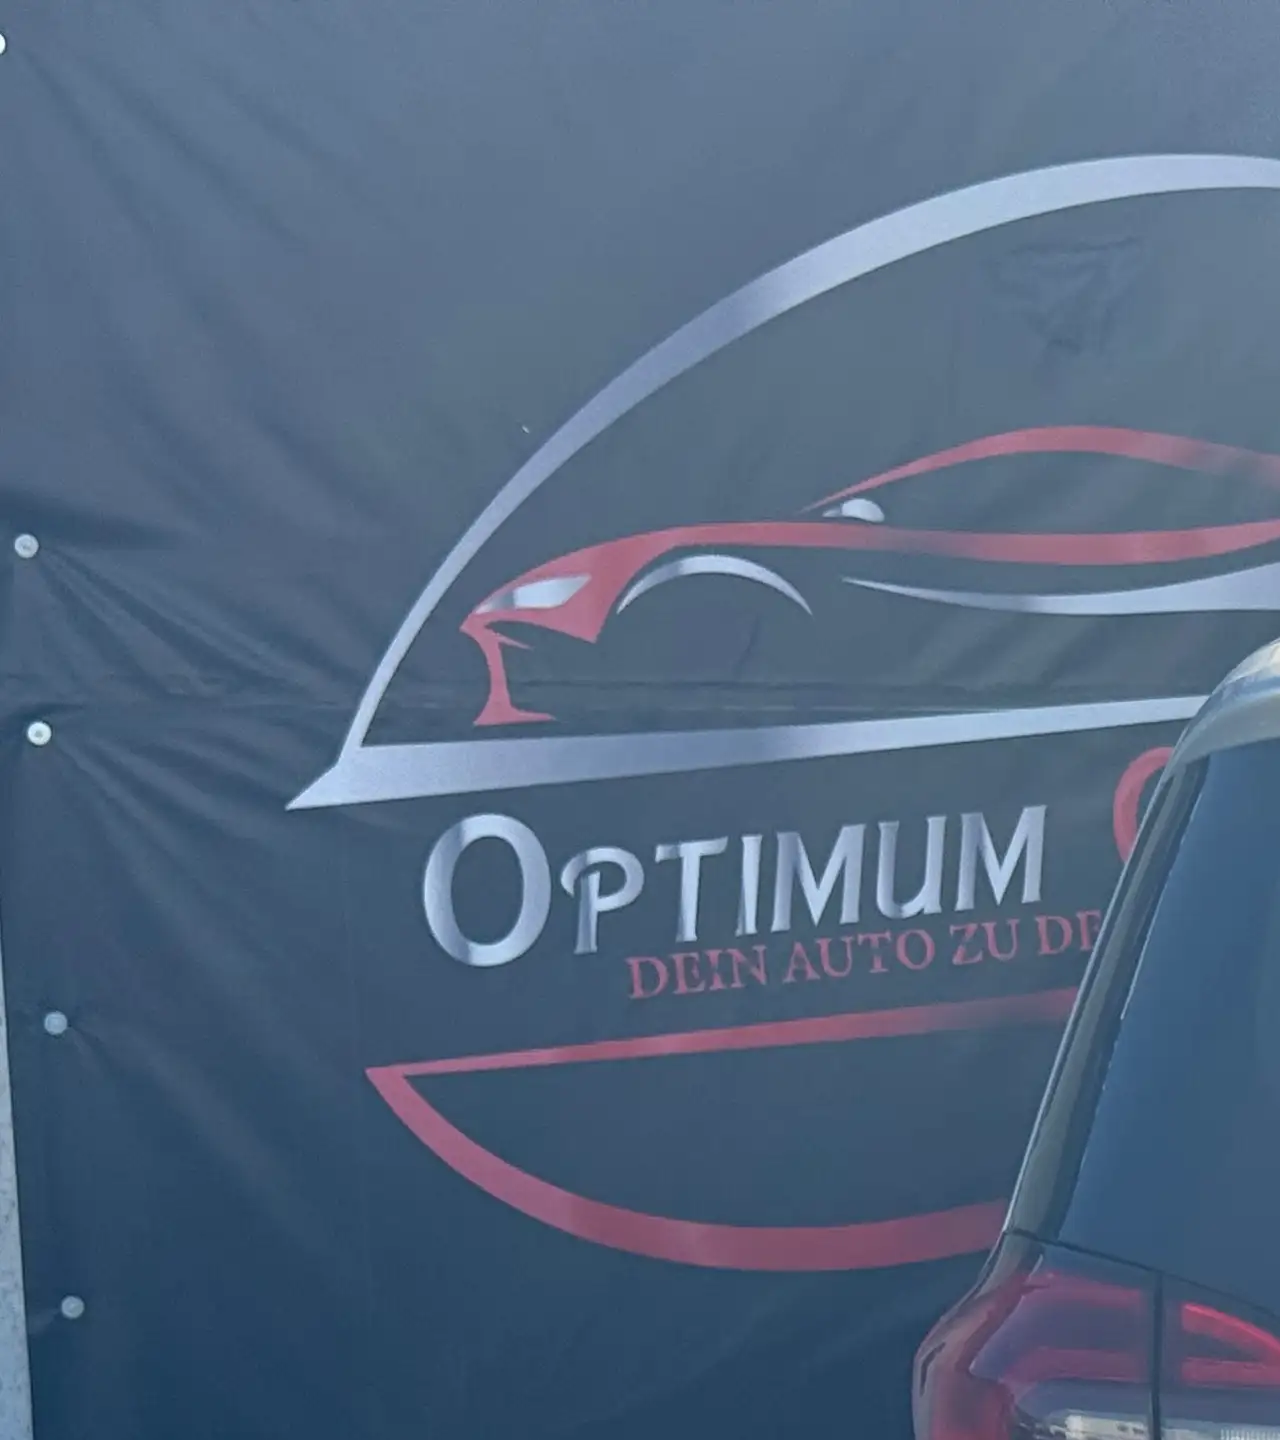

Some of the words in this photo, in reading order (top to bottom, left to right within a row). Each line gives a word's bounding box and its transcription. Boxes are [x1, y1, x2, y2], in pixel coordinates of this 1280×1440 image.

[627, 946, 768, 998] DEIN
[783, 927, 937, 982] AUTO
[949, 918, 1020, 966] ZU
